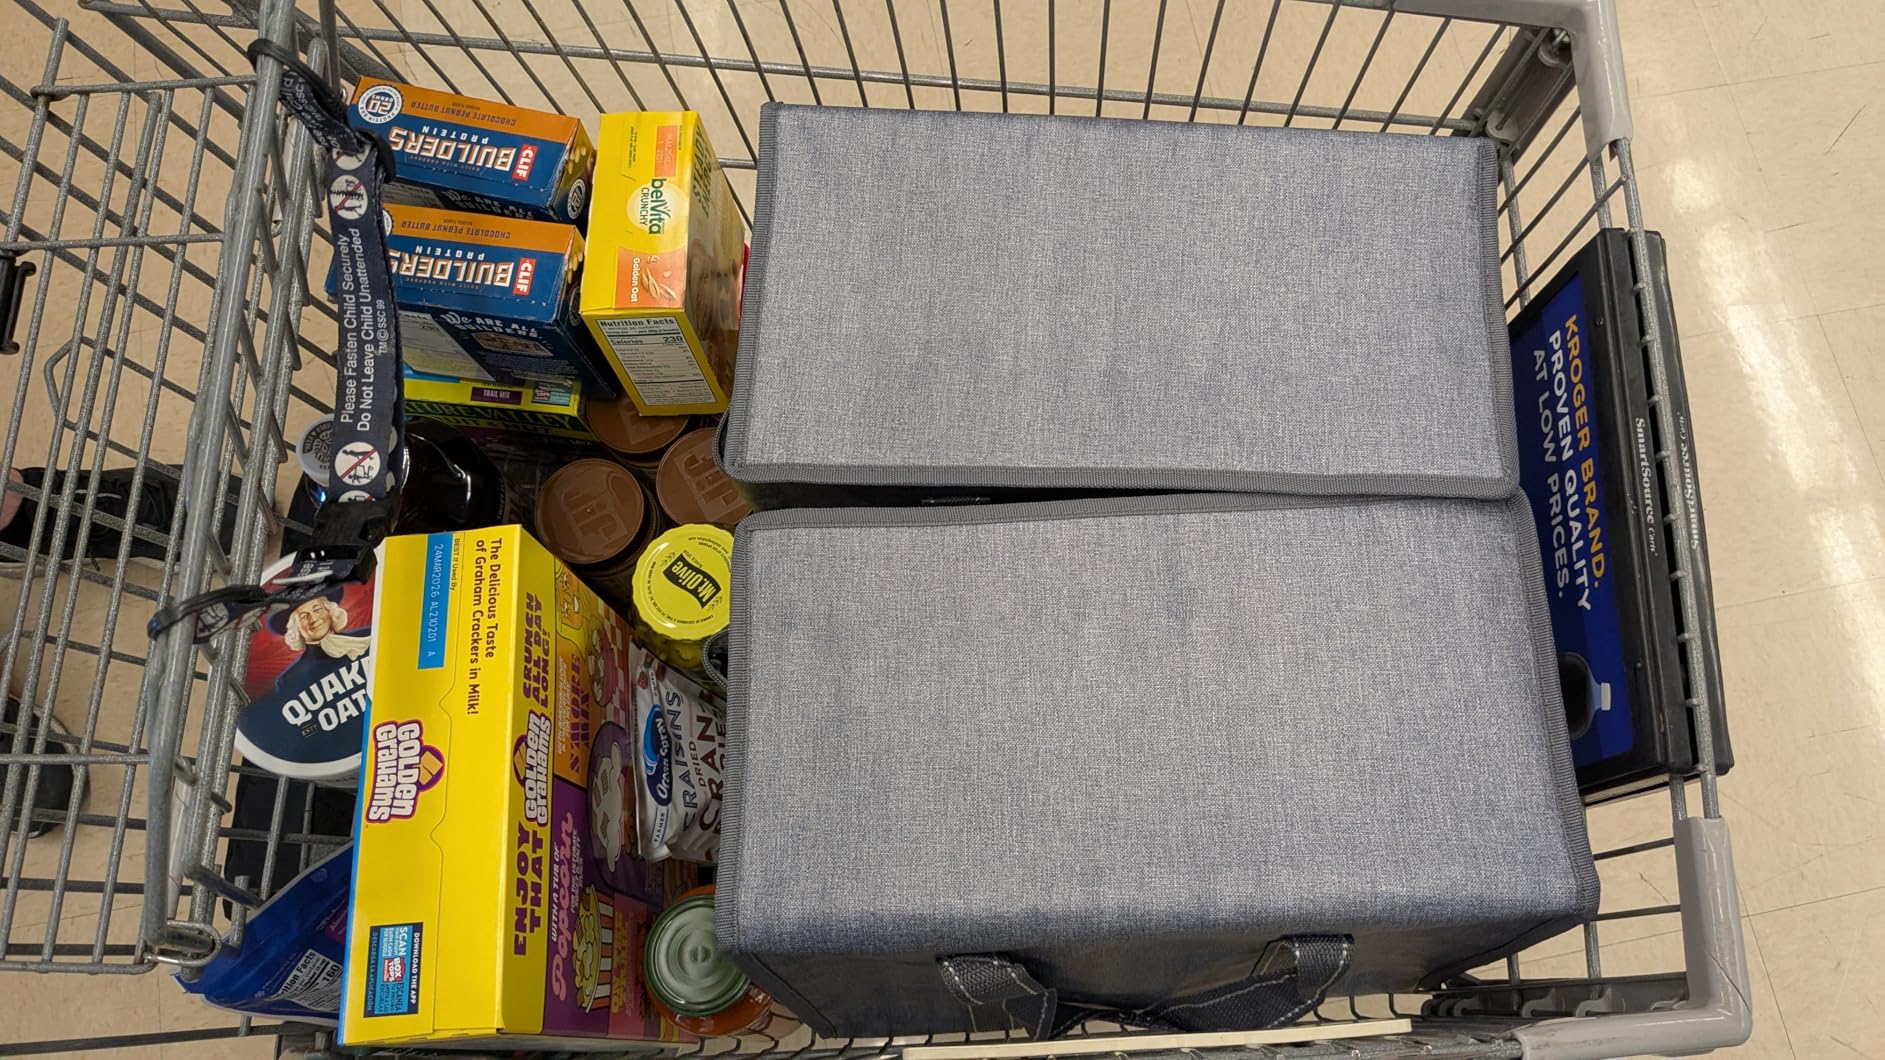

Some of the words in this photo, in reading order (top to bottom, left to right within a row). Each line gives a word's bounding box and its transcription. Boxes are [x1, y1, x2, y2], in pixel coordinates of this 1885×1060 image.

[368, 101, 393, 115] 20
[411, 101, 438, 113] BUTTER
[440, 107, 470, 120] PEANUT
[472, 111, 516, 126] CHOCOLATE
[388, 127, 516, 171] BUILDERS
[421, 125, 489, 144] PROTEIN
[514, 147, 535, 178] CLIF
[640, 187, 649, 226] CRUNCHY
[649, 178, 671, 235] belVita
[401, 220, 430, 231] BUTTER
[433, 224, 464, 234] PEANUT
[466, 227, 511, 239] CHOCOLATE
[337, 234, 354, 290] Securely
[349, 228, 372, 302] Unattended
[414, 245, 485, 260] PROTEIN
[514, 260, 533, 292] CLIF
[631, 257, 640, 286] Golden
[340, 294, 358, 329] Child
[376, 299, 385, 309] 99
[630, 287, 639, 302] Oat
[361, 306, 374, 340] Child
[344, 332, 358, 376] Fasten
[361, 344, 375, 382] Leave
[1532, 349, 1548, 382] AT
[340, 379, 357, 423] Please
[360, 386, 373, 409] Not
[483, 388, 498, 398] TRAIL
[499, 391, 511, 399] MIX
[357, 412, 371, 431] Do
[1537, 391, 1558, 463] LOW
[1564, 314, 1591, 452] KROGER
[1580, 458, 1606, 588] BRAND.
[1548, 329, 1574, 460] PROVEN
[1564, 468, 1592, 611] QUALITY
[1635, 417, 1655, 524] SmartSource
[1647, 527, 1658, 553] Carts
[1680, 443, 1700, 550] SmartSource
[476, 540, 486, 552] of
[490, 538, 502, 560] The
[1546, 473, 1570, 598] PRICES.
[431, 543, 444, 597] 24MAR2026
[450, 582, 457, 591] By
[451, 564, 459, 581] Used
[473, 557, 486, 606] Graham
[487, 564, 500, 619] Delicious
[427, 601, 437, 642] AL210201
[470, 610, 483, 664] Crackers
[533, 594, 542, 653] DAY
[486, 623, 498, 658] Taste
[522, 592, 533, 699] CRUNCH
[469, 668, 481, 680] in
[532, 655, 541, 702] ALL
[540, 628, 550, 708] LONG!
[282, 656, 371, 726] QUAK
[466, 684, 480, 715] Milk!
[318, 688, 368, 731] OAT
[655, 717, 669, 756] Spray
[657, 758, 669, 798] Ocean
[664, 691, 697, 831] CRAISINS
[688, 741, 707, 788] DRIED
[653, 812, 665, 843] FARMER
[554, 842, 560, 858] OF
[514, 820, 529, 956] ENJOY
[528, 828, 544, 934] THAT
[551, 812, 573, 1000] Popcorn
[553, 895, 559, 903] A
[399, 927, 408, 956] SCAN
[412, 932, 420, 974] DOWNLOAD
[297, 952, 315, 974] Facts
[322, 964, 340, 982] 160
[370, 965, 375, 974] LA
[395, 983, 404, 1011] ESCANEA
